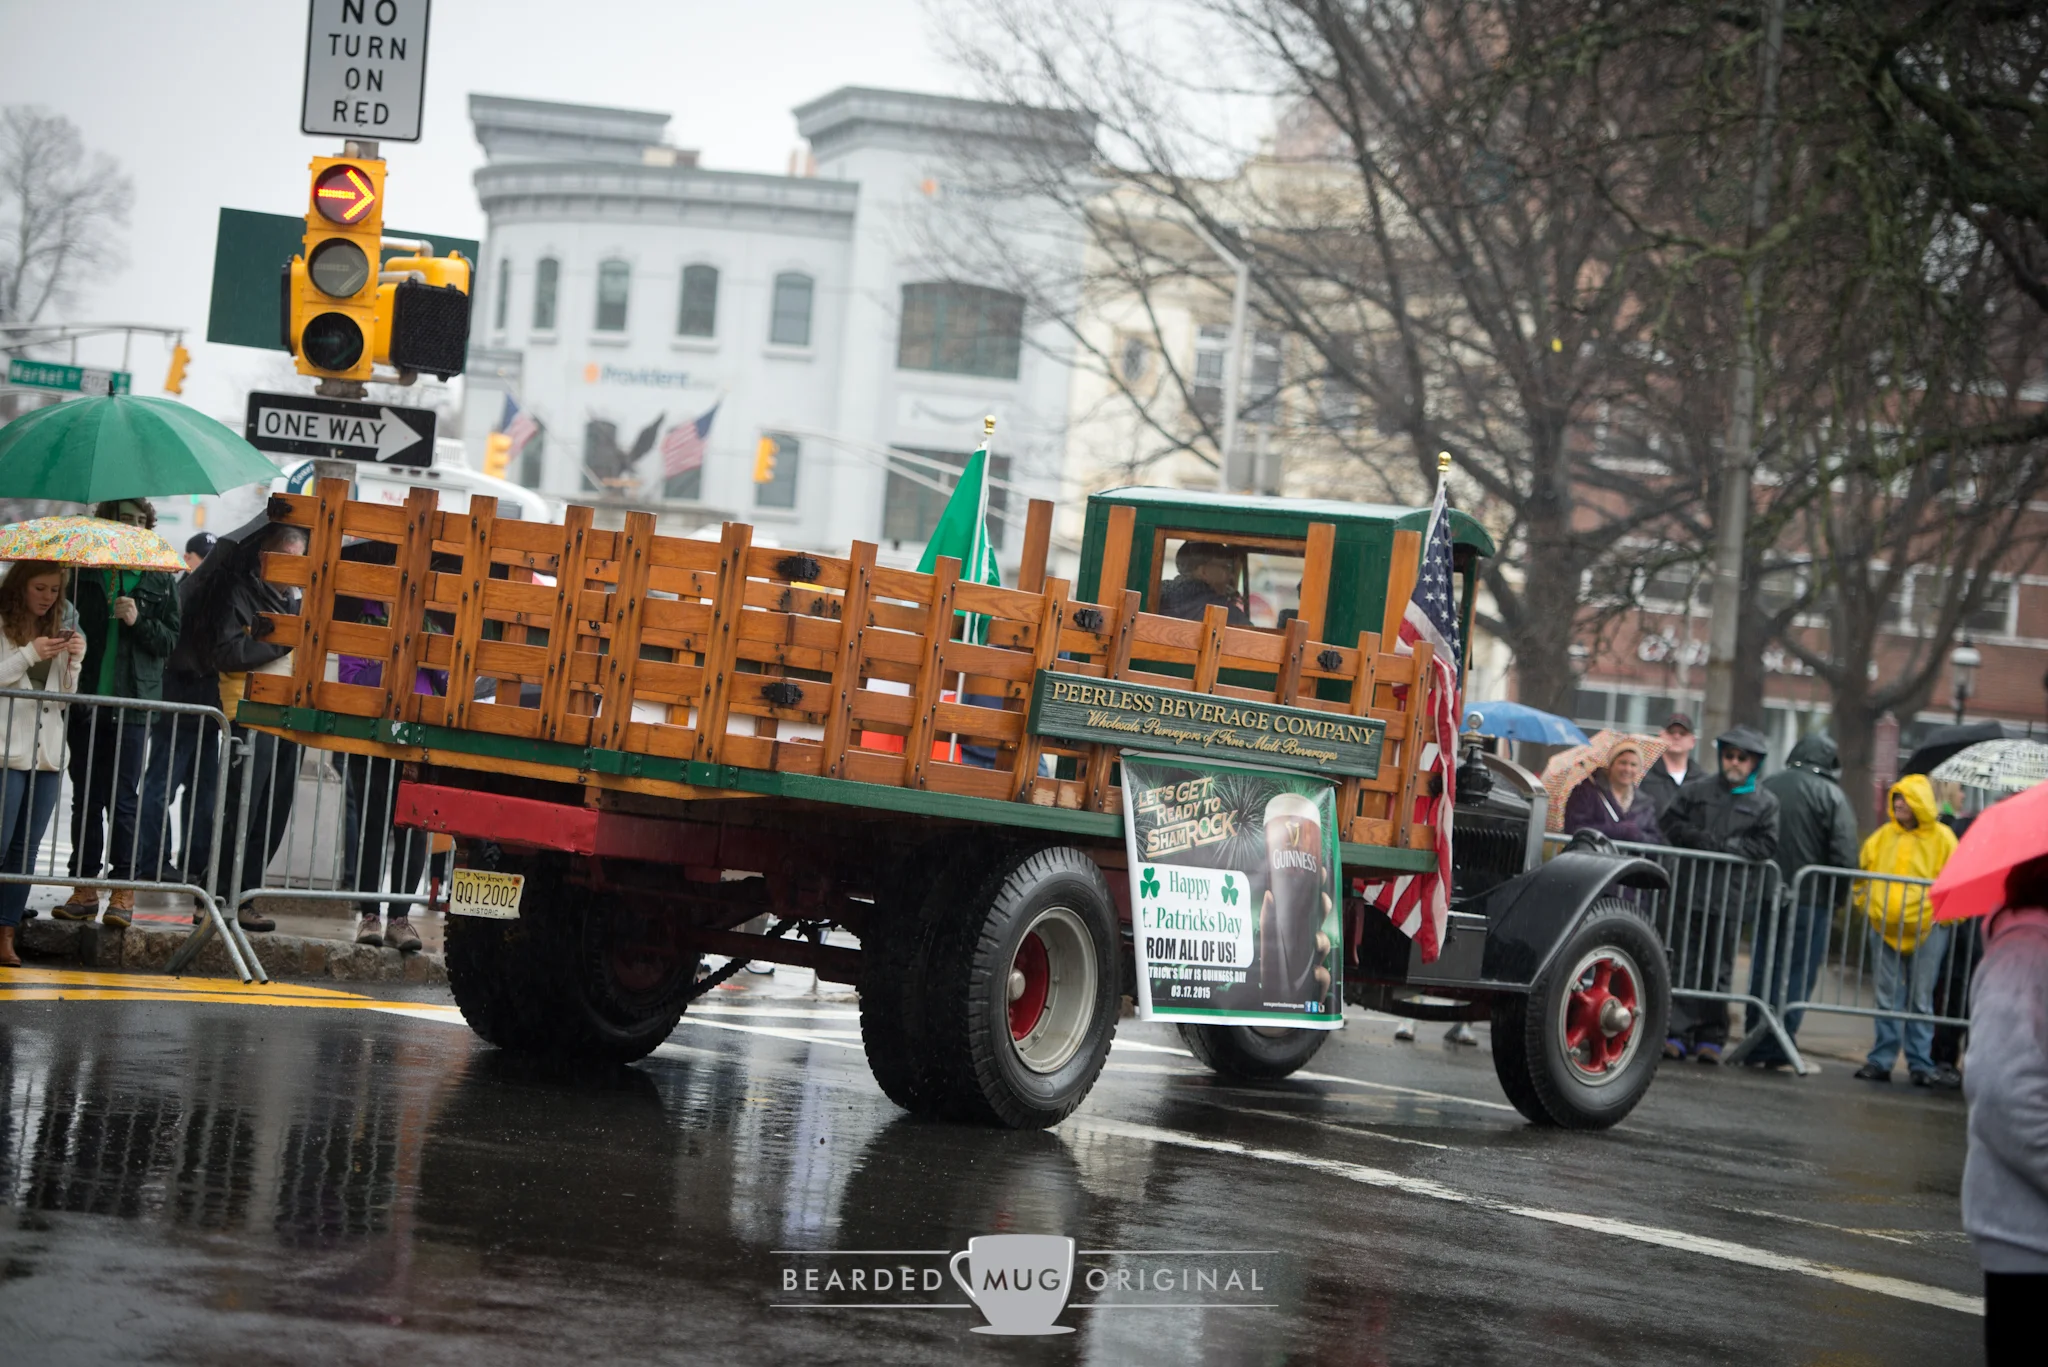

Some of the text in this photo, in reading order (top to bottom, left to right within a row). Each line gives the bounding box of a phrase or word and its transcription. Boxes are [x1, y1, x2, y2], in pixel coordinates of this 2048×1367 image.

[341, 0, 397, 25] NO
[328, 33, 406, 60] TURN
[345, 67, 383, 92] ON
[333, 100, 389, 125] RED
[265, 411, 387, 445] ONE WAY
[1052, 682, 1375, 745] PEERLESS BEVERAGE COMPANY
[1087, 709, 1338, 765] Wholesale Purveyors of Fine Malt Beverages
[1138, 776, 1213, 807] LET'S GET
[1156, 797, 1221, 826] READY TO
[1273, 849, 1317, 873] GUINNESS
[473, 873, 505, 884] New Jersey
[1169, 871, 1211, 900] Happy
[455, 881, 518, 908] QQ12002
[470, 908, 499, 916] HISTORIC
[1143, 907, 1242, 939] t. Patrick's Day
[1146, 937, 1237, 963] ROM ALL OF US!
[1149, 966, 1247, 983] TRICK'S DAY IS GUINNESS DAY
